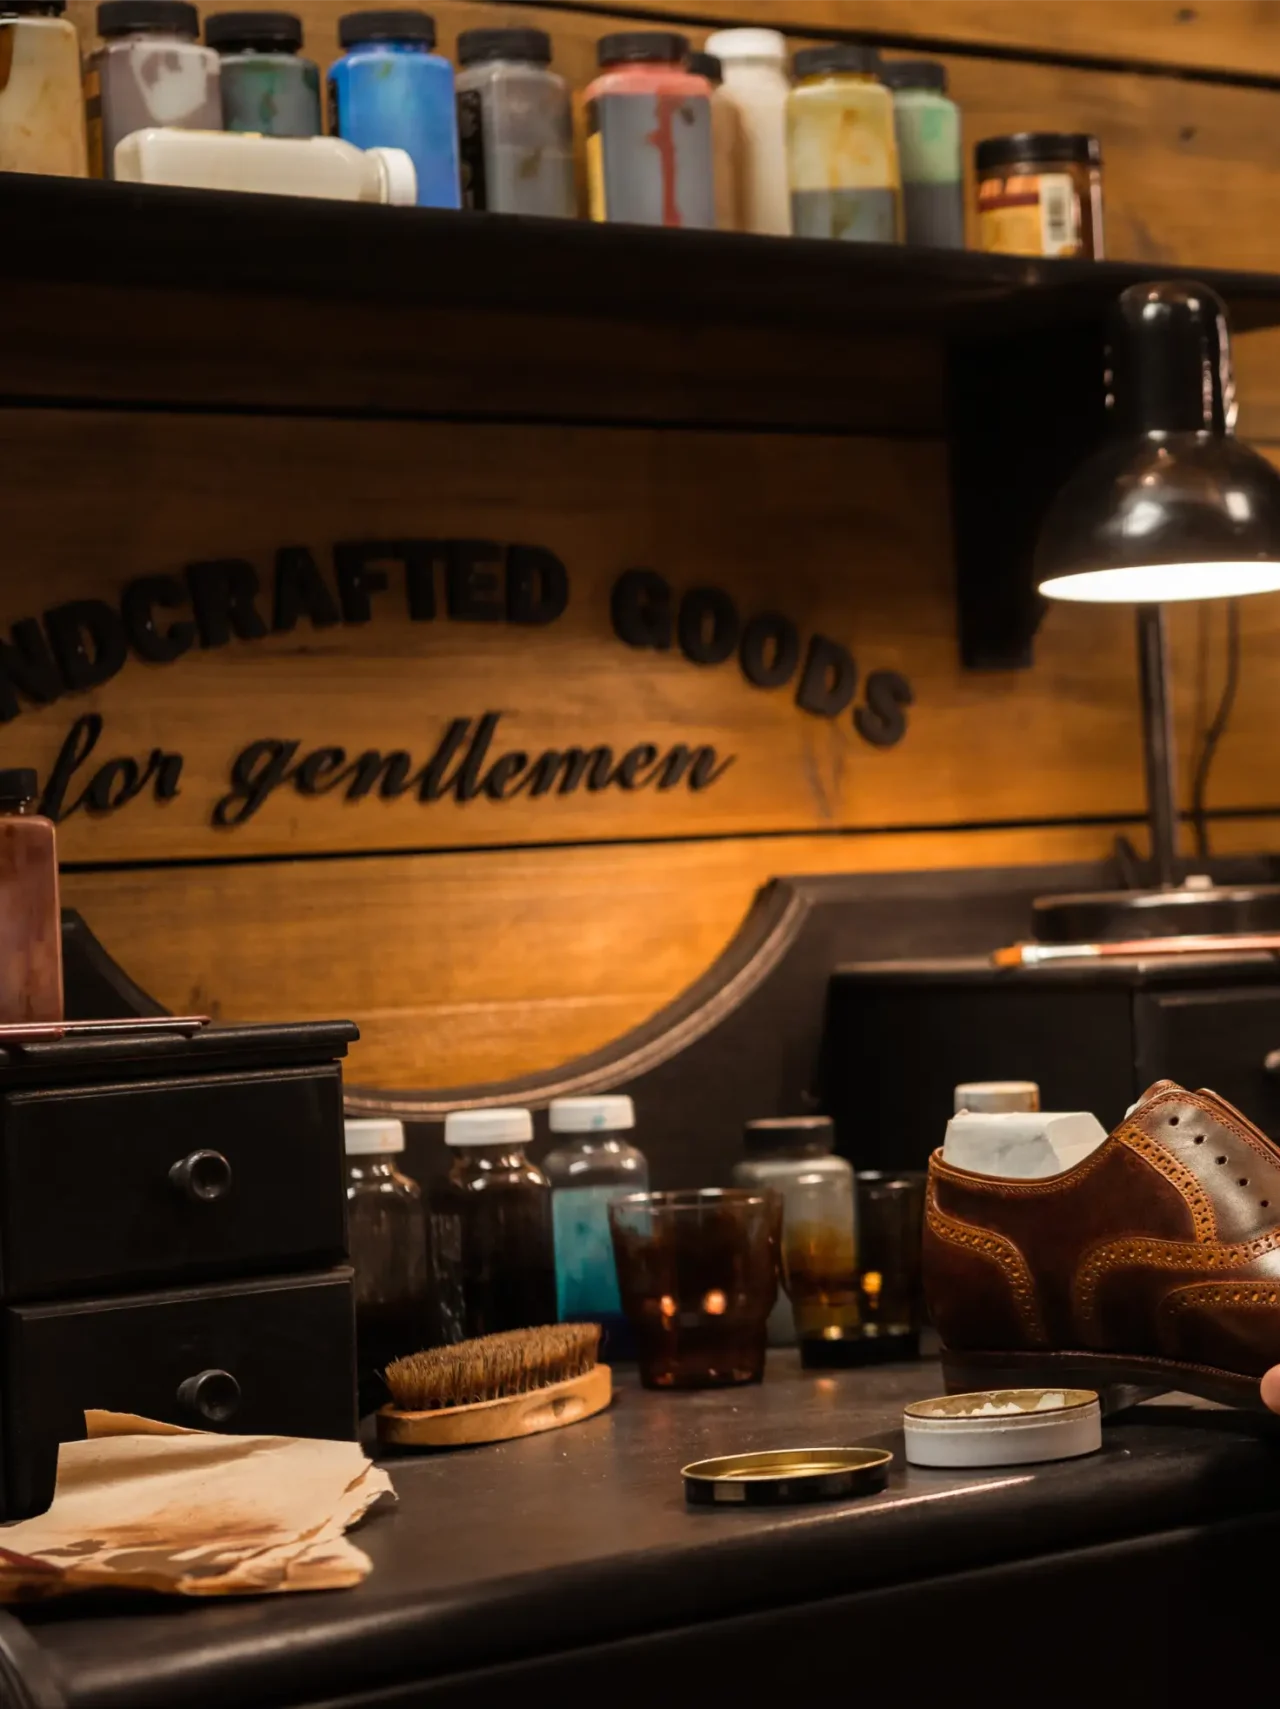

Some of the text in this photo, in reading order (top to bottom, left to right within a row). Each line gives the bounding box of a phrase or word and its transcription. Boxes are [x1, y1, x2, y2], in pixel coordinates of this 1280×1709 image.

[610, 569, 914, 747] GOODS
[36, 711, 733, 828] for gentlemen
